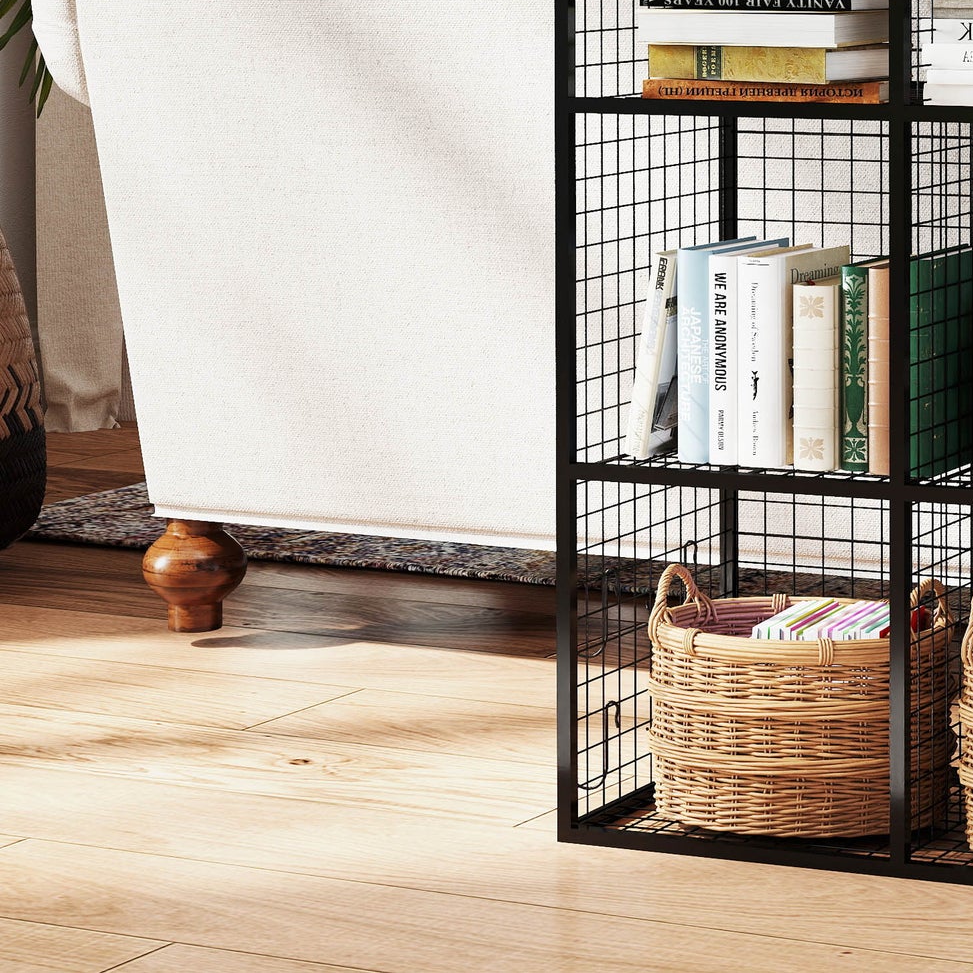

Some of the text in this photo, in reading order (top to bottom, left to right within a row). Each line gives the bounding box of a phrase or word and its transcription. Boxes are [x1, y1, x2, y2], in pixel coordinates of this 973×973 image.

[685, 85, 737, 97] ГРЕЦИИ
[738, 86, 798, 98] ДРЕВНЕЙ
[801, 87, 864, 97] ИСТОРИЯ
[655, 256, 668, 291] FRANK
[790, 263, 839, 285] Dreaming
[690, 306, 702, 384] JAPANESE
[714, 272, 727, 391] WE ARE ANONYMOUS
[680, 306, 691, 422] ARCHITECTURE
